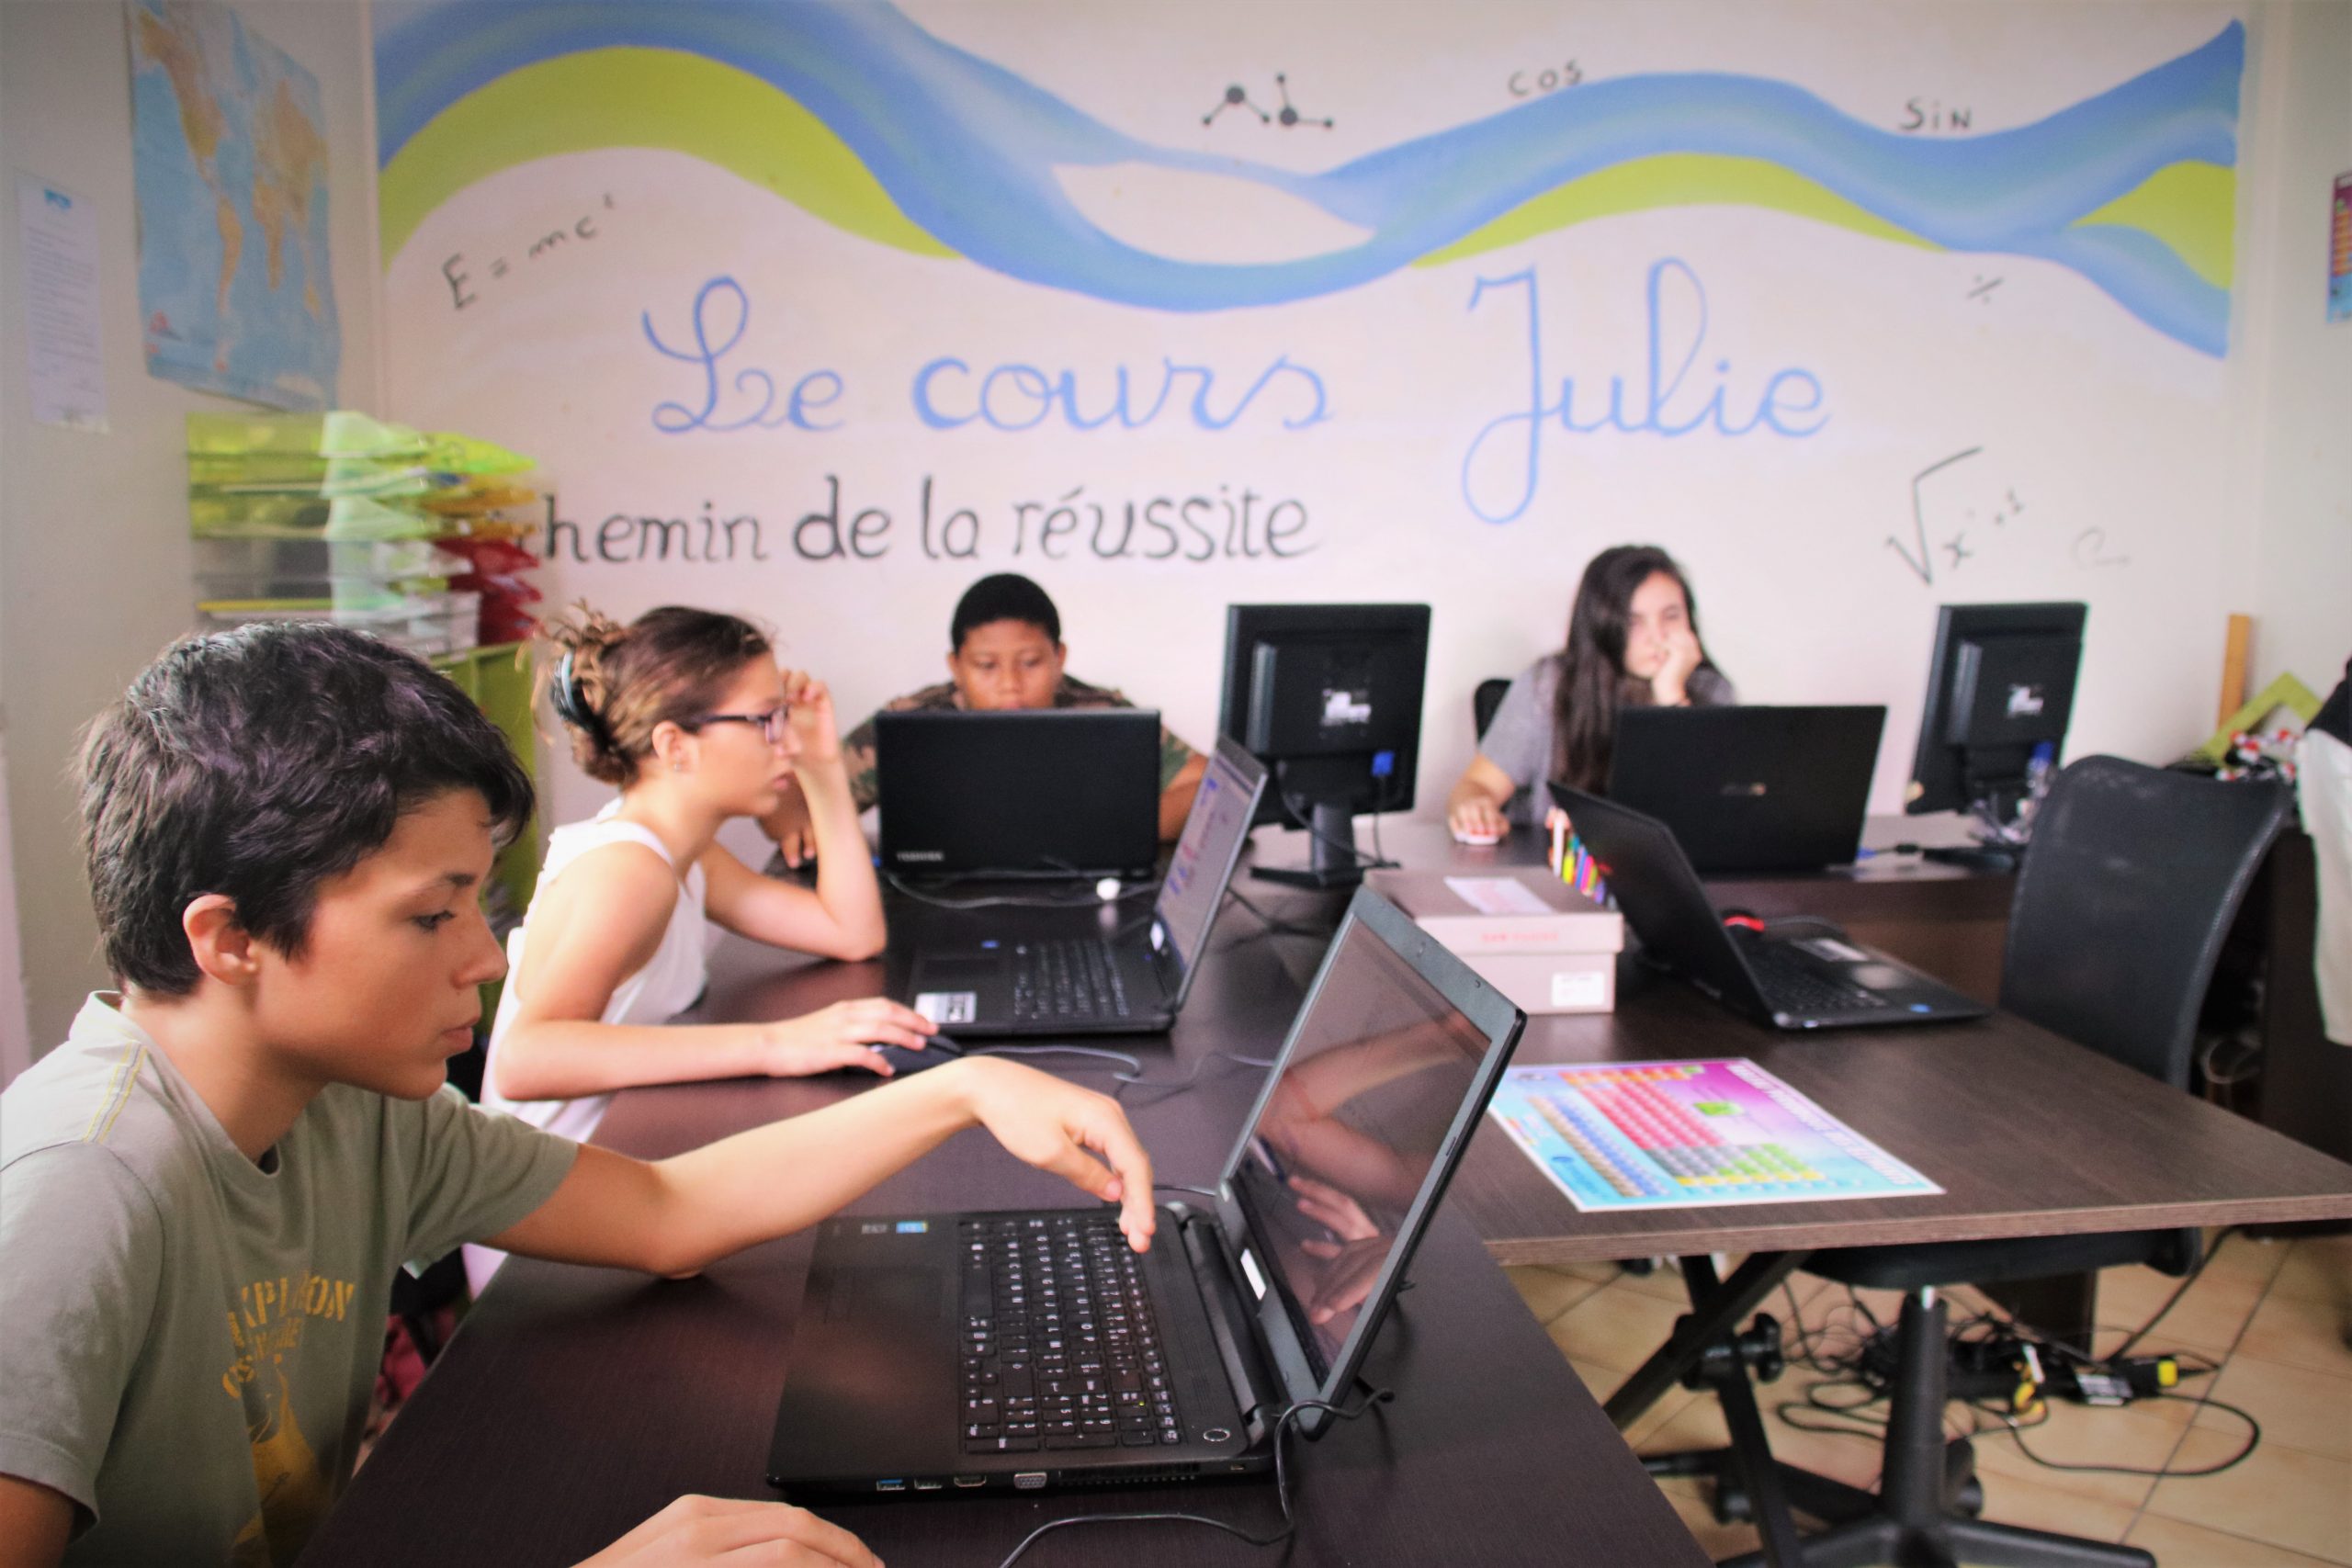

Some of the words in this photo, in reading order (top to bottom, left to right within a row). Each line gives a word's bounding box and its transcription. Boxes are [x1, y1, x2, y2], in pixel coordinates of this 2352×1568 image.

[640, 275, 847, 434] Le
[910, 353, 1337, 431] cours
[1462, 254, 1833, 526] Julie
[516, 491, 769, 564] hemin
[792, 473, 893, 561] de
[921, 473, 981, 559] la
[1011, 485, 1325, 561] réussite
